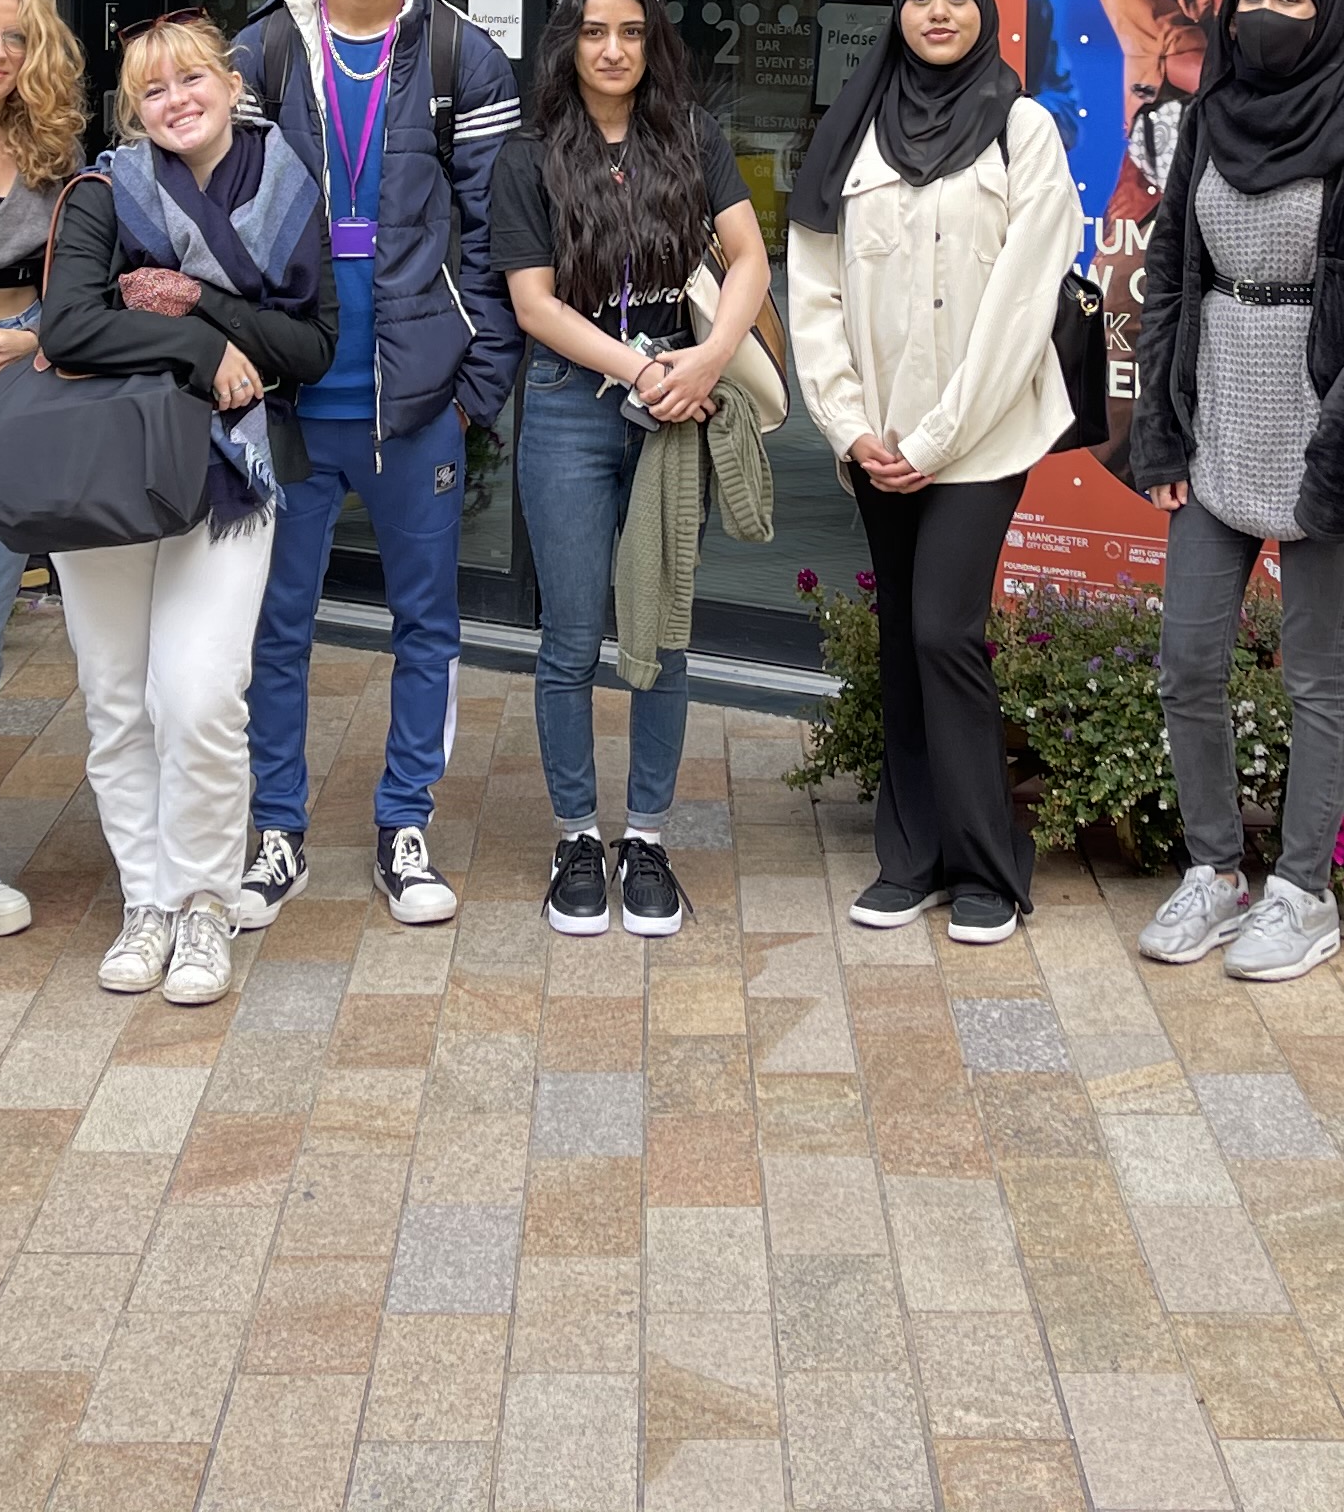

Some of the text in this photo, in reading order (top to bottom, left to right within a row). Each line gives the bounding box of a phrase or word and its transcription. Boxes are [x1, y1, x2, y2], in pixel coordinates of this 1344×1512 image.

[471, 13, 520, 25] Automatic
[714, 20, 811, 64] 2 CINEMAS
[828, 30, 877, 46] Please
[756, 40, 780, 52] BAR
[756, 57, 794, 69] EVENT
[1035, 514, 1045, 523] BY
[1027, 531, 1089, 548] MANCHESTER
[1026, 541, 1071, 554] CITY COUNCIL
[1129, 548, 1146, 556] ARTS
[1129, 555, 1160, 565] ENGLAND
[1004, 561, 1087, 579] FOUNDING SUPPORTERS
